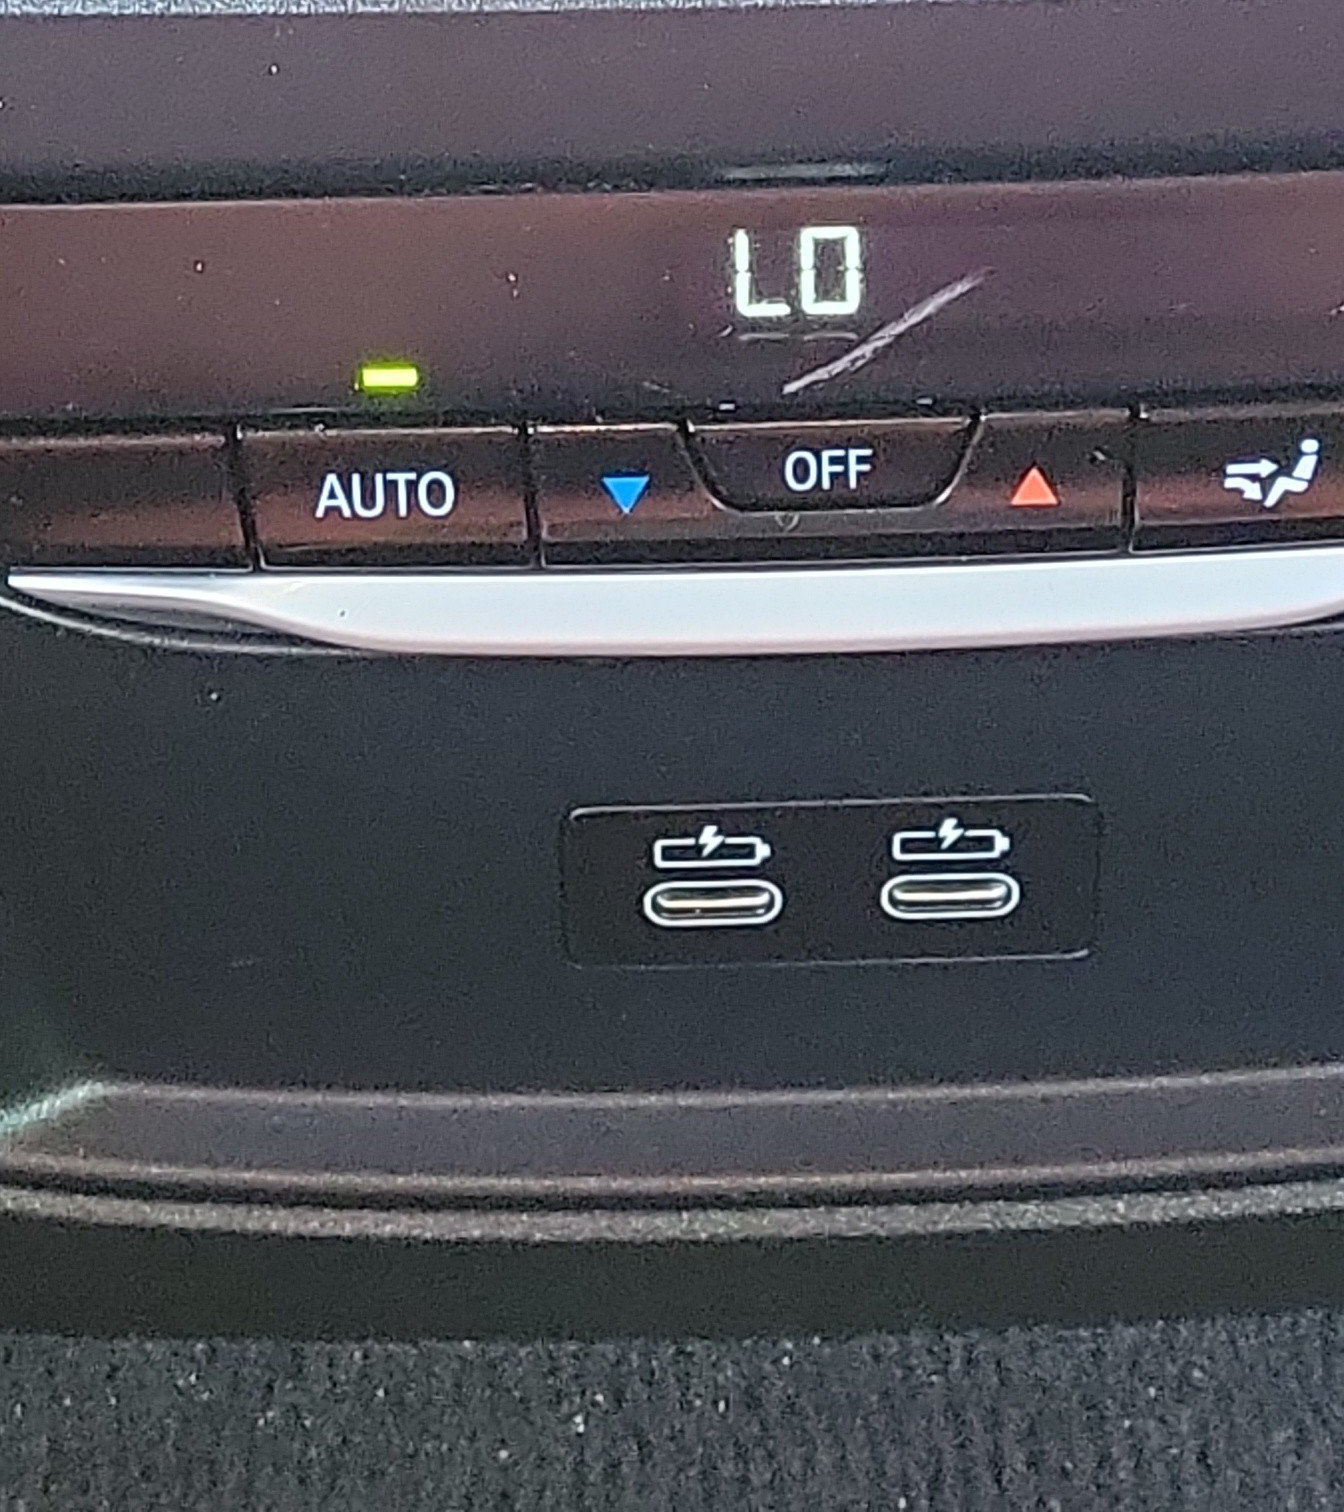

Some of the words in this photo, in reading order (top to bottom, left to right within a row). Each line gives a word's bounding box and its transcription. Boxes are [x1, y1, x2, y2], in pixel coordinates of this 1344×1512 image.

[732, 226, 862, 317] LO
[783, 447, 873, 492] OFF
[315, 470, 456, 520] AUTO
